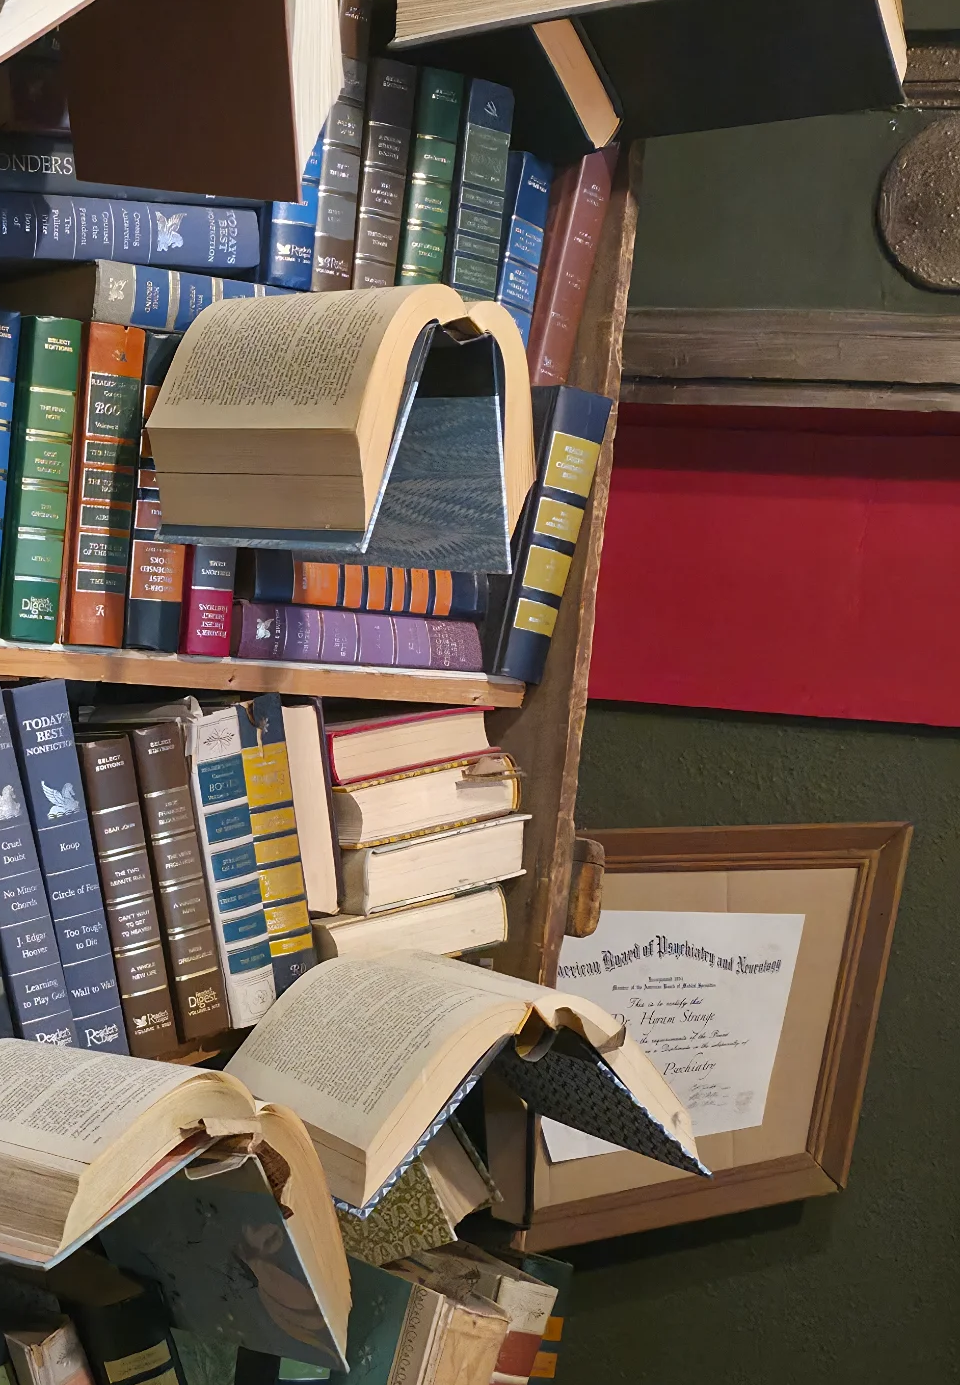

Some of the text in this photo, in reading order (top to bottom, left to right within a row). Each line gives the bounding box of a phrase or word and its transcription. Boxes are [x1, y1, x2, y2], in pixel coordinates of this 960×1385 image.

[206, 208, 214, 262] NONFICTION
[219, 220, 227, 252] BEST
[228, 210, 236, 264] TODAY'S
[44, 343, 73, 352] EDITIONS
[48, 338, 71, 346] SELECT
[36, 727, 64, 742] BEST
[98, 755, 120, 764] SELECT
[2, 839, 22, 850] Cruel
[60, 842, 80, 852] Koop
[4, 853, 26, 864] Doubt
[4, 890, 15, 899] No
[52, 886, 85, 900] Circle of
[11, 899, 37, 911] Chords
[64, 922, 102, 938] Too Tough
[17, 933, 46, 947] J. Edgar
[86, 938, 98, 946] Die
[23, 946, 48, 958] Hoover
[558, 960, 601, 979] erican
[601, 942, 640, 972] Board
[643, 939, 653, 957] of
[656, 935, 716, 967] Psychiatry
[717, 956, 733, 972] and
[25, 979, 58, 993] Learning
[71, 980, 115, 998] Wall to Wall
[34, 995, 49, 1005] Play
[85, 1024, 118, 1047] Reader's
